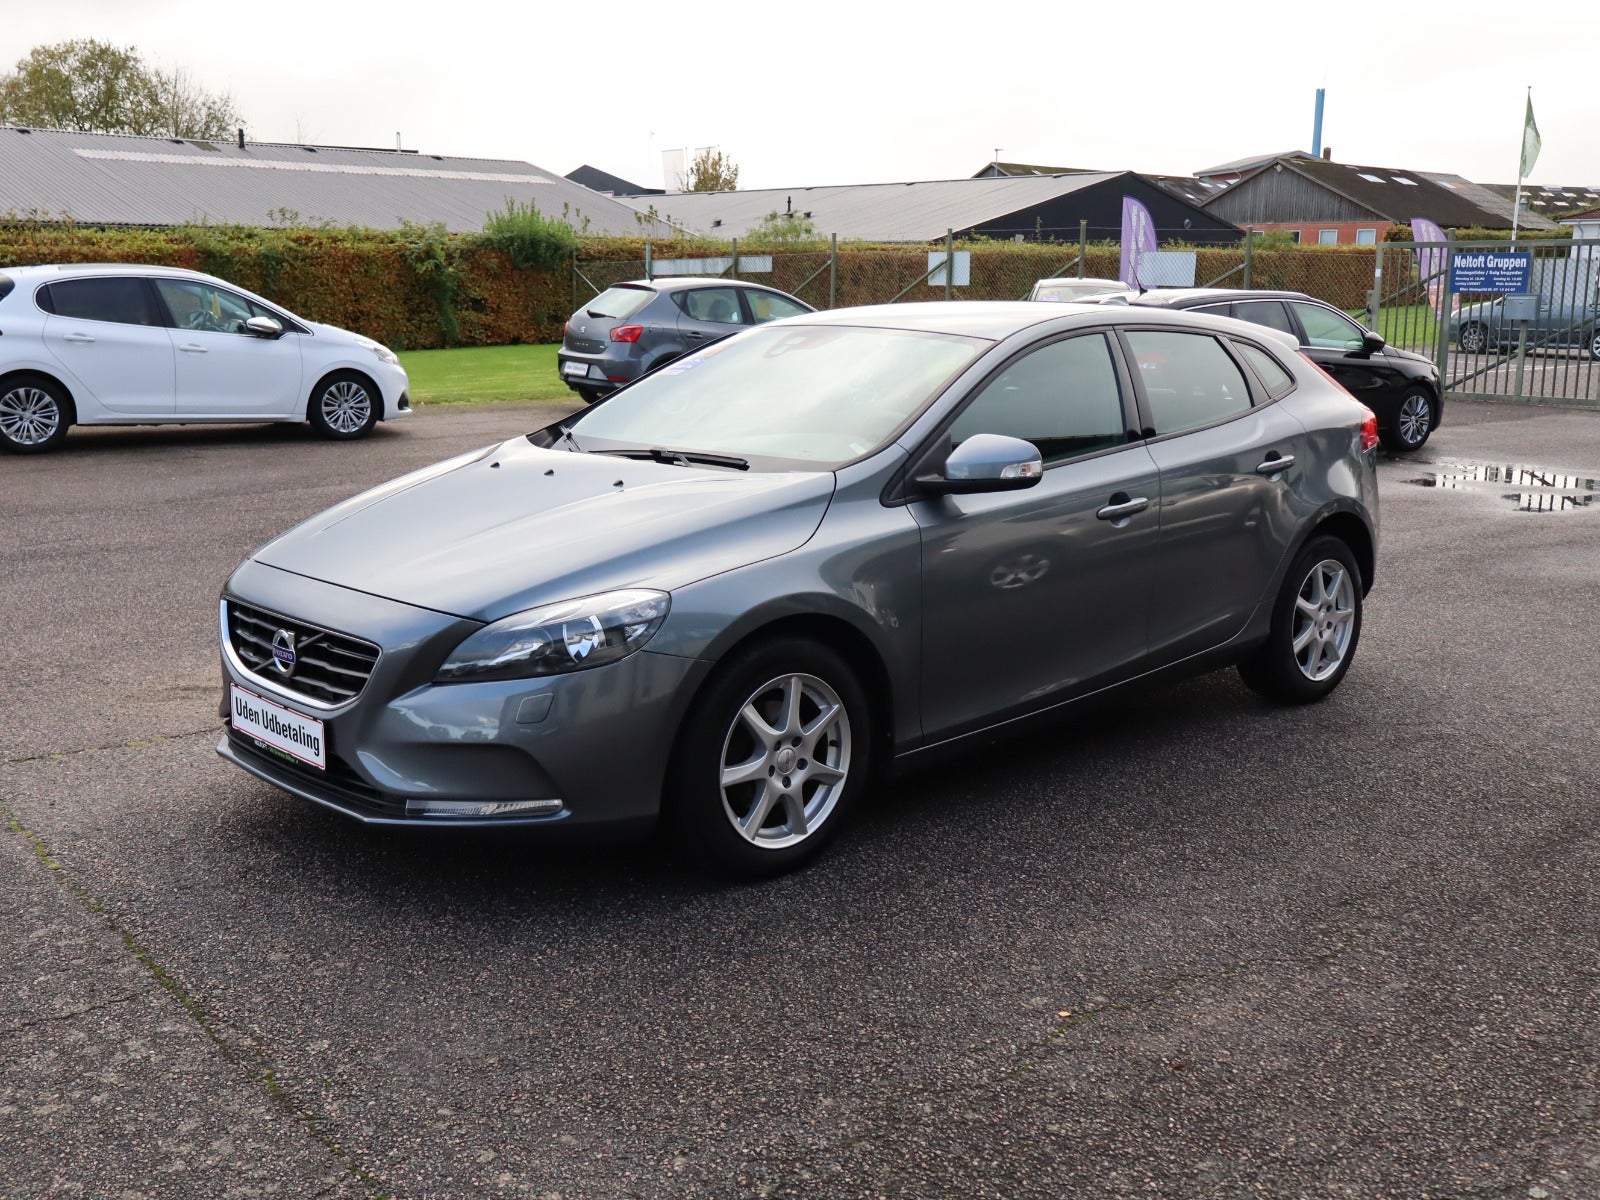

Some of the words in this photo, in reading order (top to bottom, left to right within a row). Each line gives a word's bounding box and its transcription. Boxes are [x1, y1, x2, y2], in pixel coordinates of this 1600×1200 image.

[1454, 255, 1485, 268] Neltoft
[1486, 255, 1527, 270] Gruppen
[235, 696, 260, 725] Uden
[261, 708, 320, 757] Udbetaling
